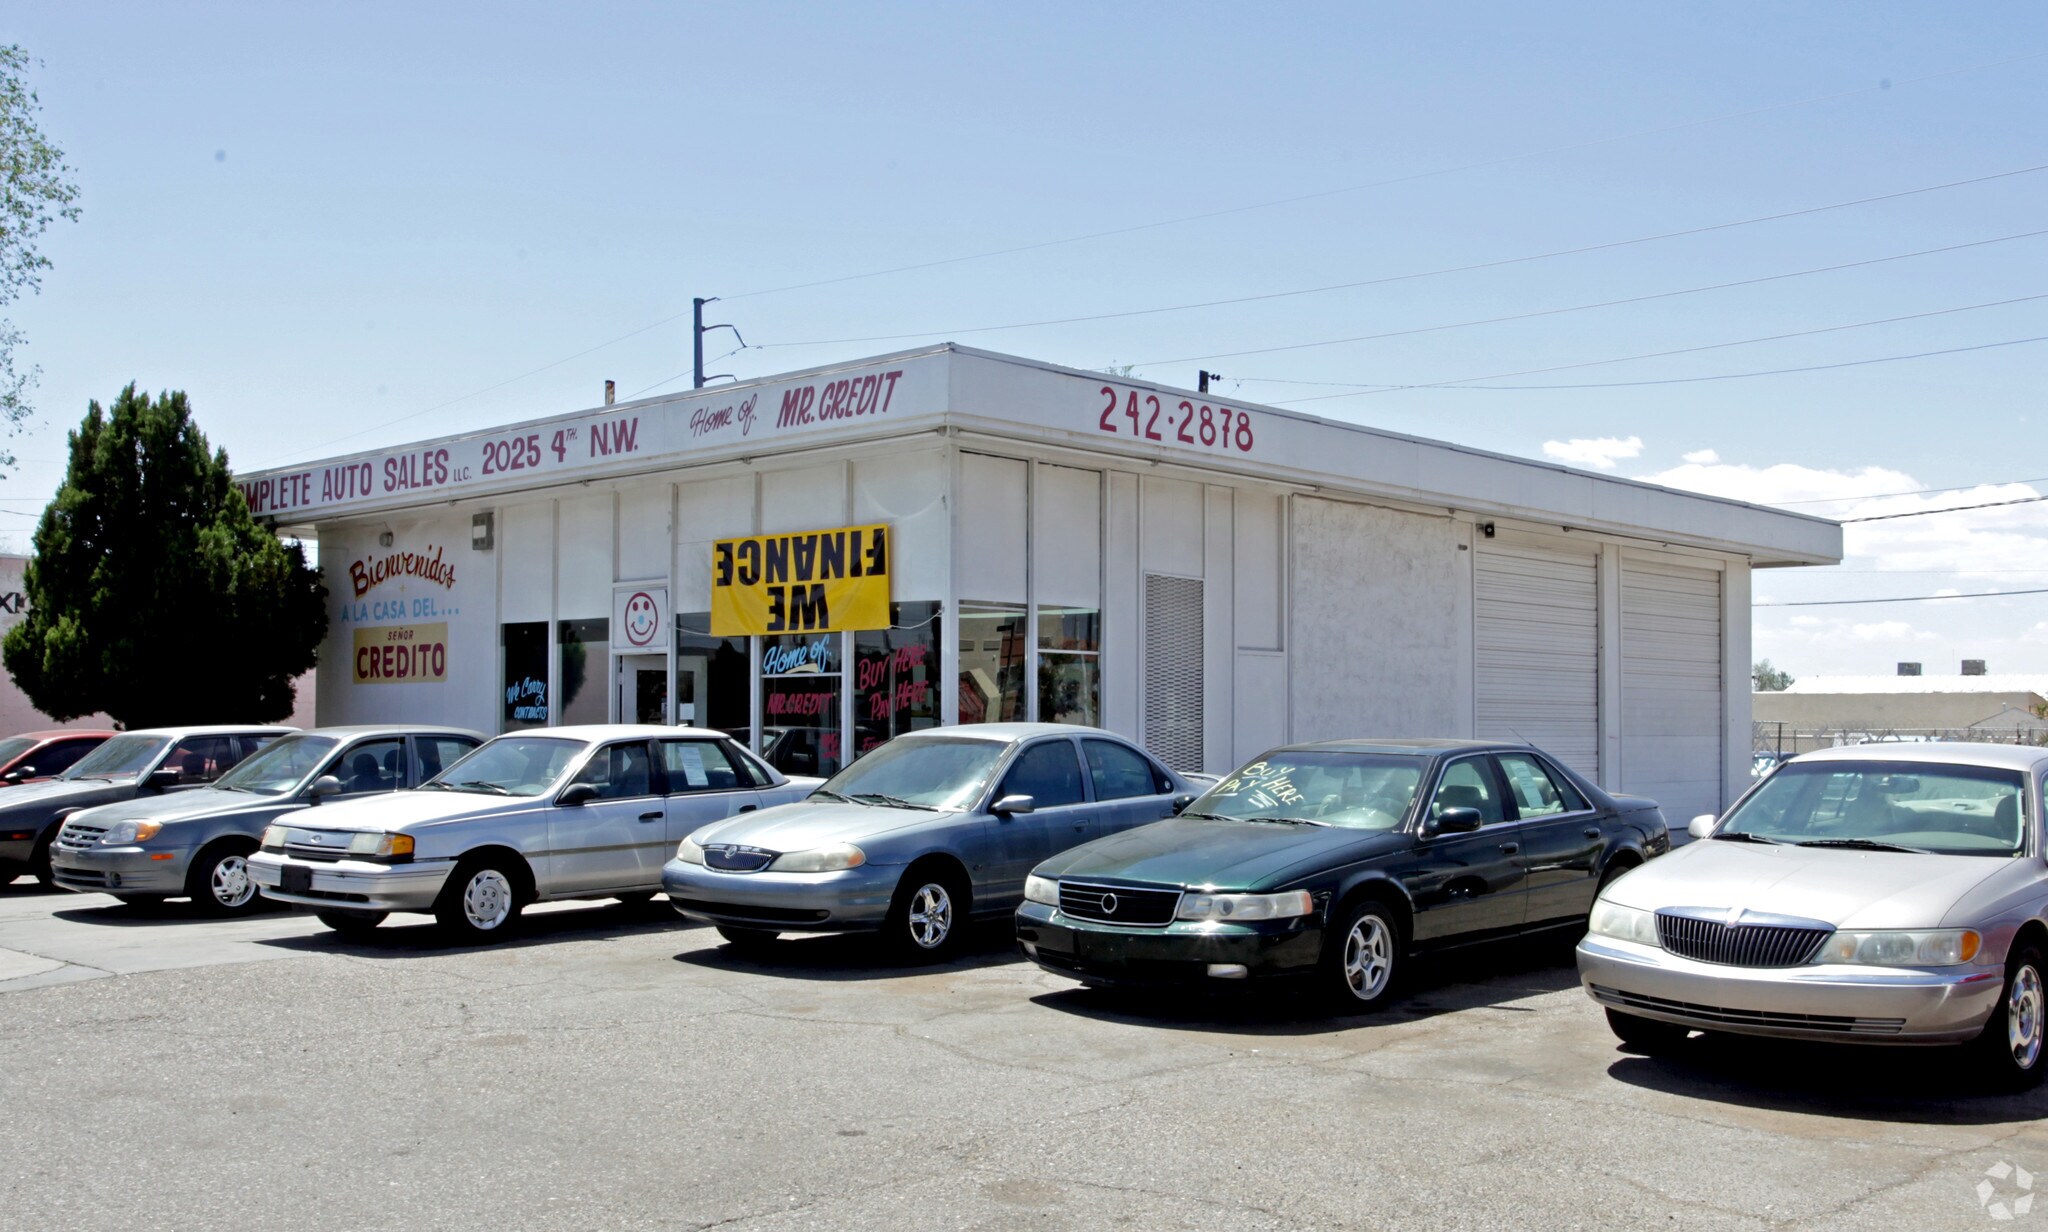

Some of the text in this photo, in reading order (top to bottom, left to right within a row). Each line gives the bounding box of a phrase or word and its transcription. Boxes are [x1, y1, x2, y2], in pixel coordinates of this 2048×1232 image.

[690, 406, 733, 438] Home
[776, 385, 815, 429] MR.
[819, 371, 903, 421] CREDIT
[236, 473, 311, 512] MPLETE
[321, 462, 372, 502] AUTO
[383, 449, 449, 492] SALES
[482, 434, 541, 475] 2025
[590, 417, 638, 458] N.W.
[350, 545, 456, 598] Bienvenidos
[716, 528, 886, 587] FINANCE
[341, 605, 350, 622] A
[353, 603, 368, 622] LA
[373, 600, 405, 621] CASA
[767, 583, 829, 631] WE
[387, 626, 414, 641] SEÑOR
[356, 642, 445, 679] CREDITO
[763, 645, 807, 674] Home
[859, 655, 890, 690] BUY
[521, 677, 546, 706] Carry
[896, 680, 929, 711] HERE
[1242, 761, 1296, 778] BUY
[1215, 779, 1260, 794] PAY
[1261, 776, 1304, 806] HERE
